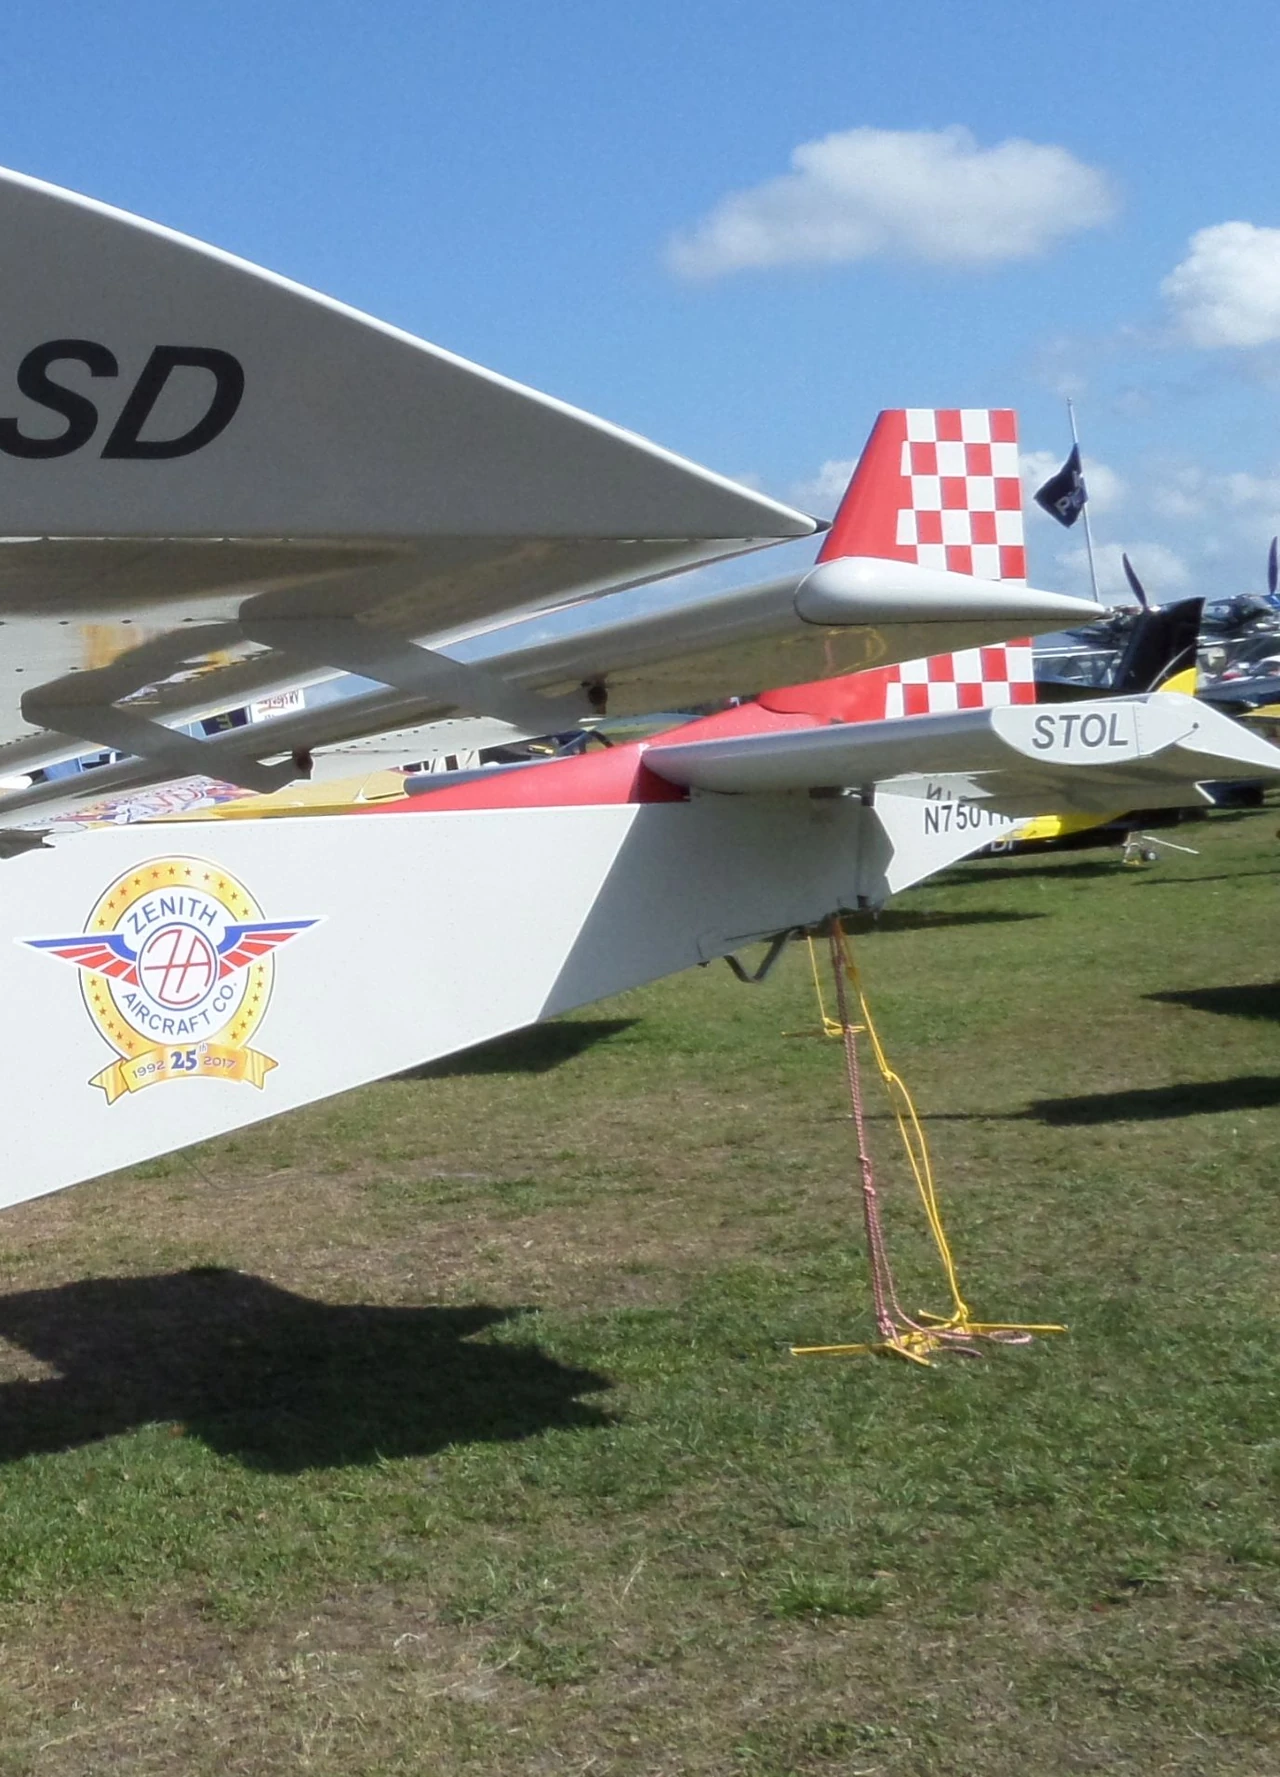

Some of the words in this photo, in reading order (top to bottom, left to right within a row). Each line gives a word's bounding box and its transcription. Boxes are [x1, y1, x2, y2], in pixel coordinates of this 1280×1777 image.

[1032, 713, 1129, 749] STOL
[126, 896, 219, 936] ZENITH
[122, 992, 211, 1035] AIRCRAFT
[132, 1060, 166, 1079] 1992
[203, 1055, 236, 1069] 2017
